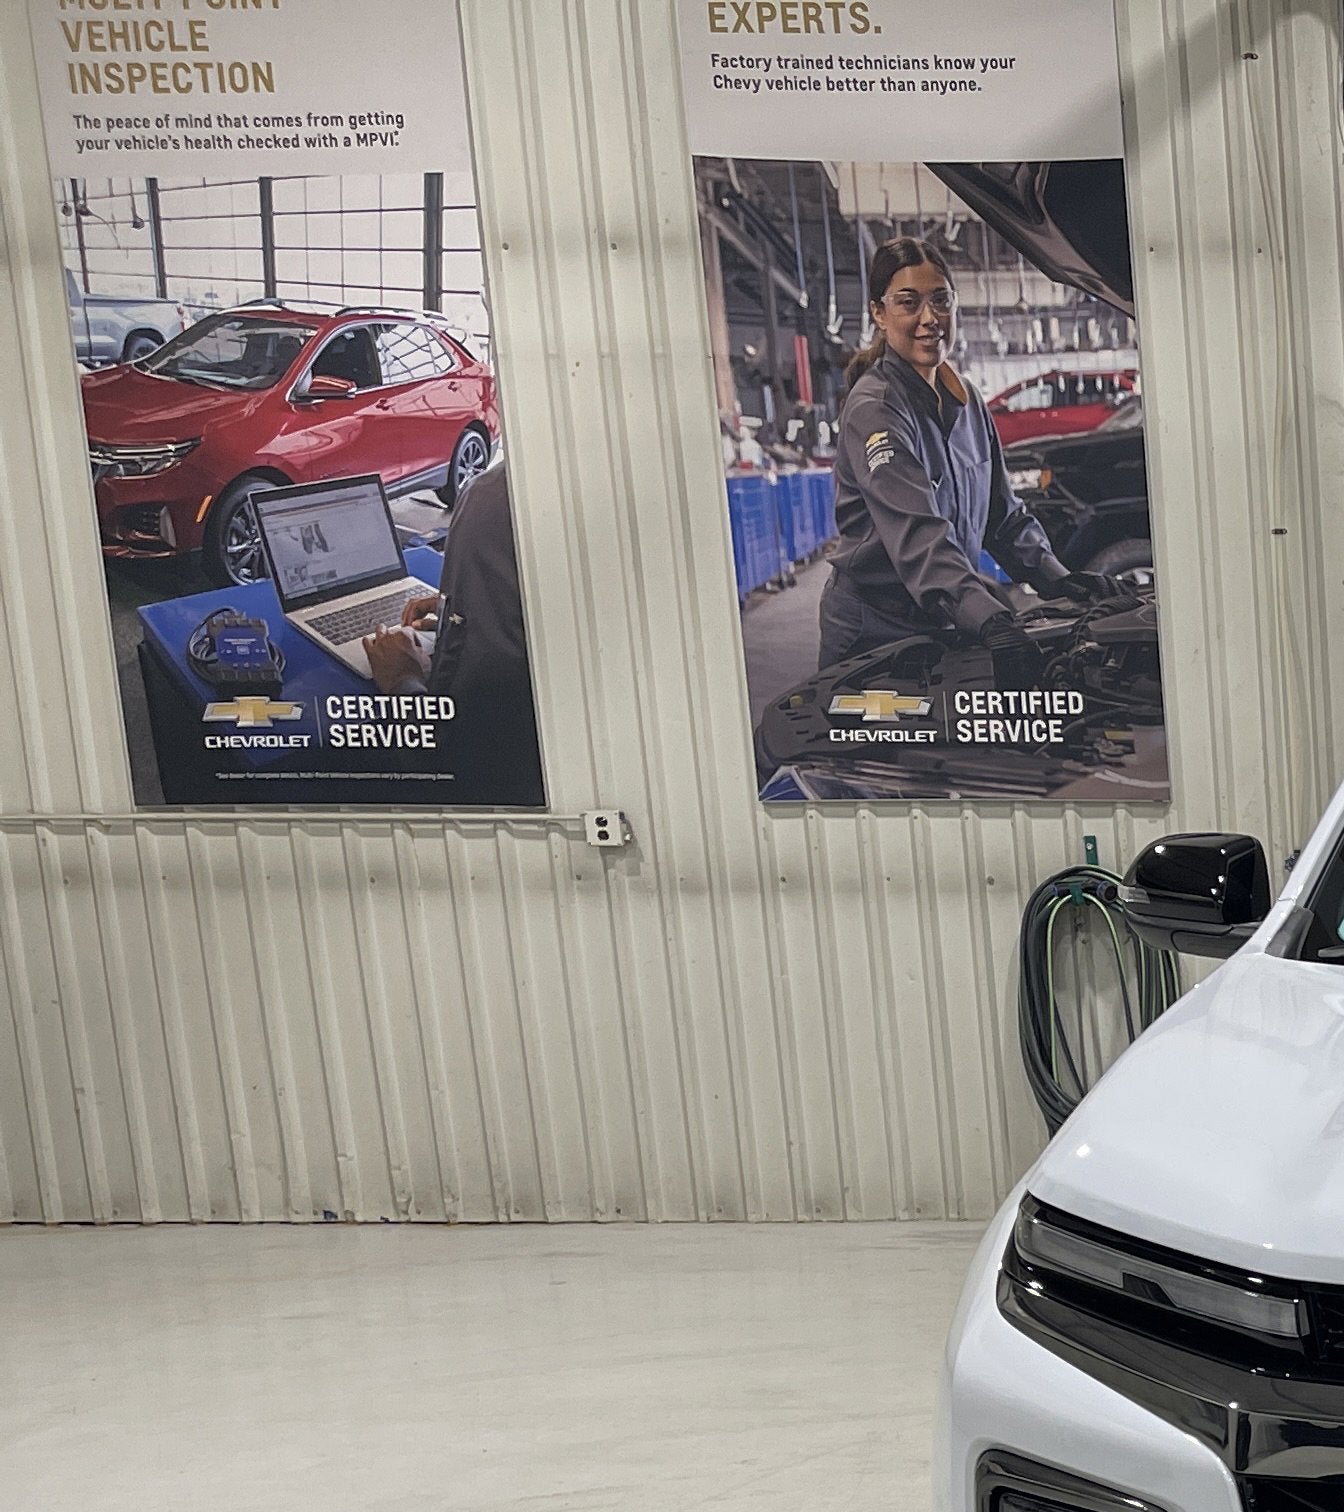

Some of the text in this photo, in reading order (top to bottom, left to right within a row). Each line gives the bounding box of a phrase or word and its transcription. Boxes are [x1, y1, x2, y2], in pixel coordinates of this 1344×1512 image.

[708, 2, 882, 34] EXPERTS.
[61, 20, 209, 52] VEHICLE
[711, 53, 1016, 73] Factory trained technicians know your
[68, 62, 275, 94] INSPECTION
[713, 74, 982, 95] Chevy vehicle better than anyone.
[73, 110, 404, 132] The peace of mind that comes from getting
[76, 138, 110, 154] your
[115, 134, 180, 150] vehicle's
[184, 134, 233, 150] health
[237, 134, 300, 149] checked
[304, 133, 339, 148] with
[343, 136, 351, 148] a
[326, 695, 456, 720] CERTIFIED
[954, 690, 1084, 715] CERTIFIED
[204, 734, 312, 749] CHEVROLET
[329, 724, 437, 748] SERVICE
[829, 729, 938, 743] CHEVROLET
[956, 719, 1065, 743] SERVICE
